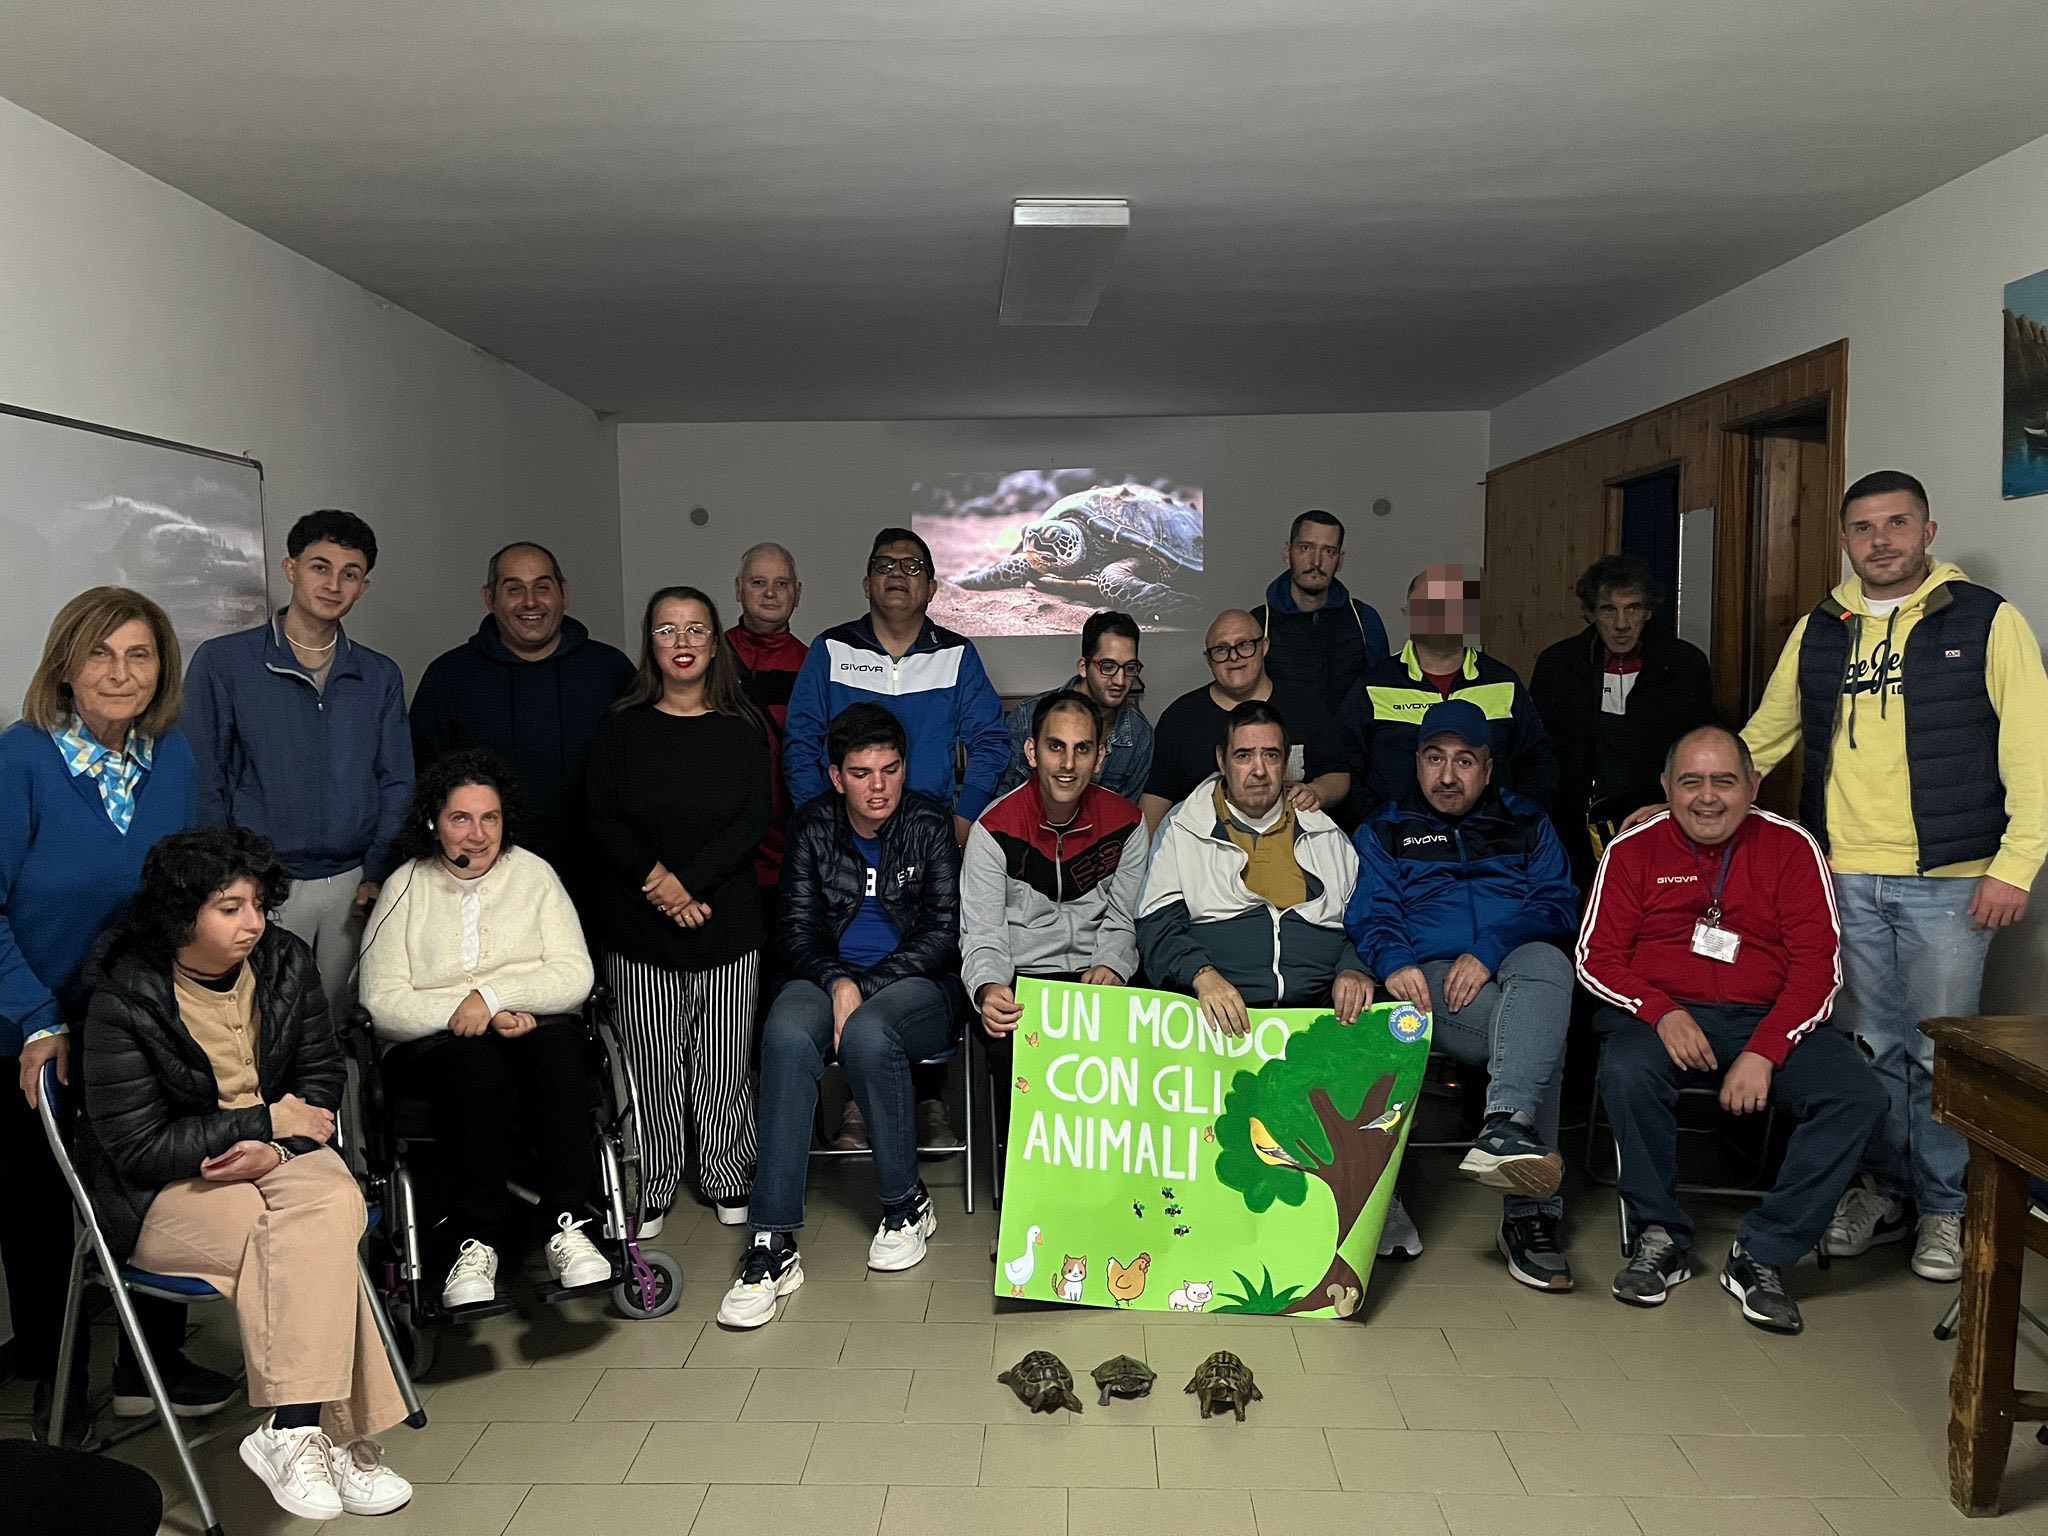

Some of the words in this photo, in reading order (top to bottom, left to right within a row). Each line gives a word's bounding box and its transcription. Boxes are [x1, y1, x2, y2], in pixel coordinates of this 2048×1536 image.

[841, 663, 883, 673] GIVOVA
[1403, 835, 1448, 847] GIVOVA
[1657, 875, 1698, 884] GIVOVA
[1041, 987, 1100, 1042] UN
[1045, 1053, 1139, 1107] CON
[1152, 1064, 1222, 1115] GLI
[1022, 1110, 1198, 1182] ANIMALI
